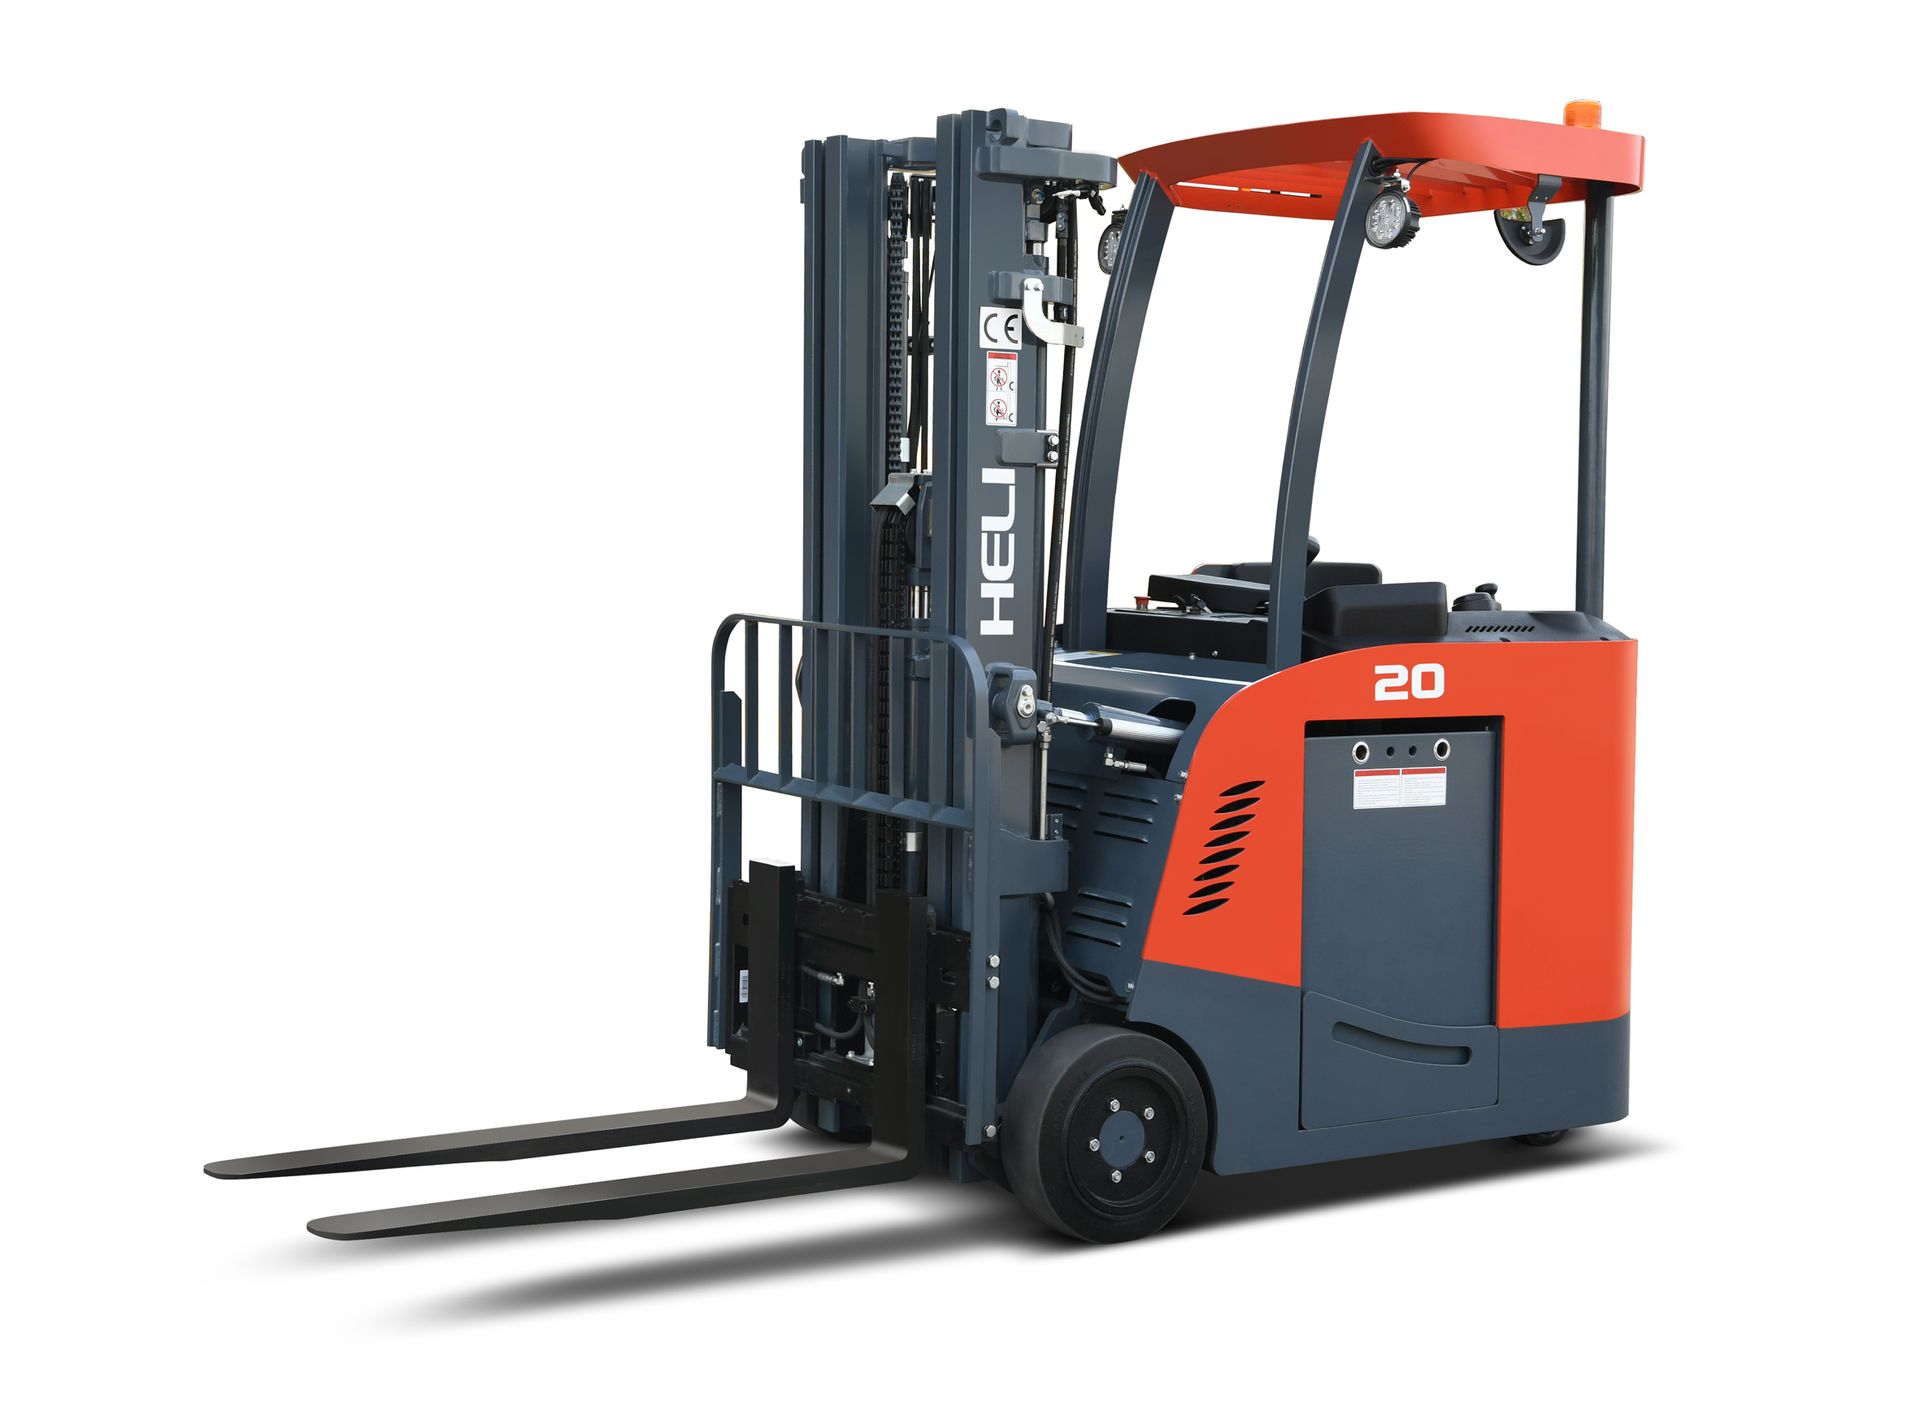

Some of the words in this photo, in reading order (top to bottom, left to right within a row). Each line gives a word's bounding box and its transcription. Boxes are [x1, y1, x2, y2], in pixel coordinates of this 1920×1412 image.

[983, 313, 1018, 344] CE
[980, 467, 1016, 636] HELI
[1374, 663, 1445, 701] 20
